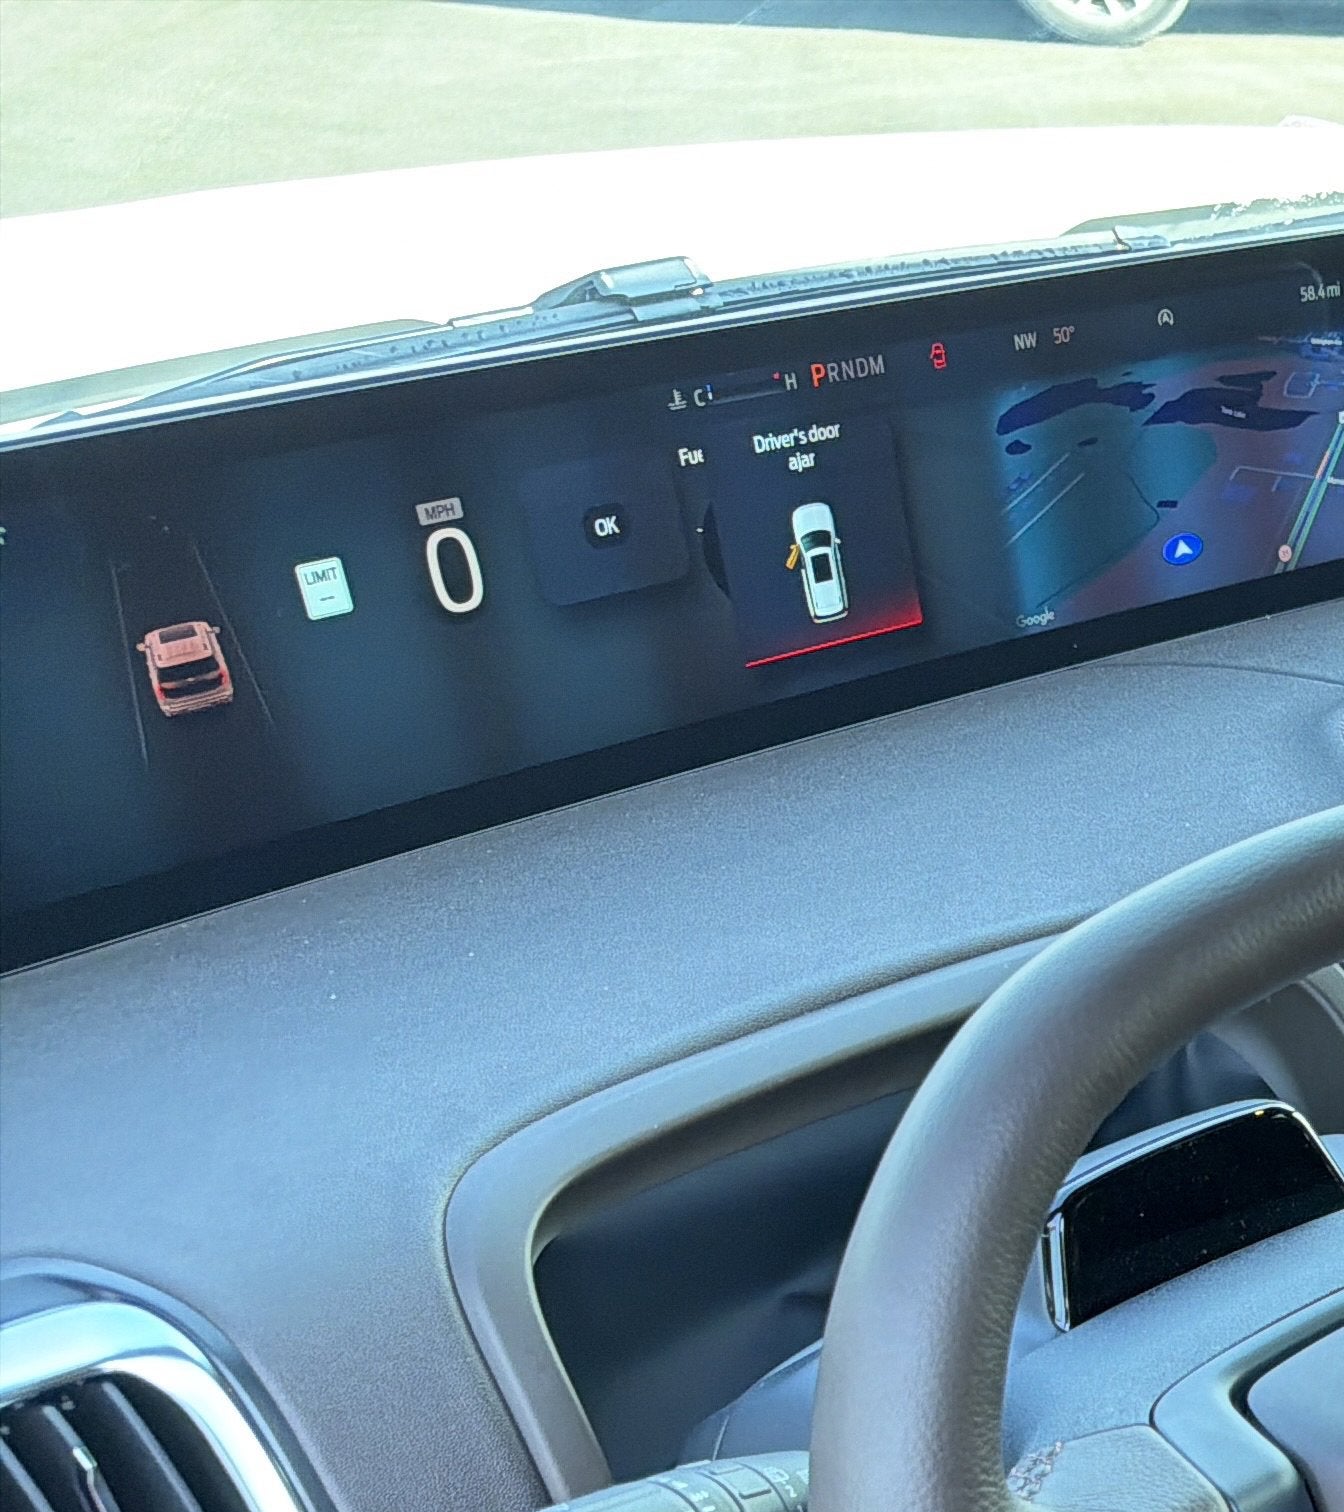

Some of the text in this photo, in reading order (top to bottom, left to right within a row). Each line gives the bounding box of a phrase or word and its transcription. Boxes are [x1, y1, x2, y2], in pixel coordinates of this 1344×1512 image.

[1013, 331, 1037, 351] NW
[784, 372, 798, 391] H
[693, 388, 706, 408] C
[753, 422, 841, 454] Driver's door
[788, 450, 816, 473] ajar
[423, 502, 456, 521] MPH
[593, 515, 621, 537] OK
[304, 566, 338, 586] LIMIT
[426, 527, 484, 613] 0
[1015, 605, 1056, 628] Google
